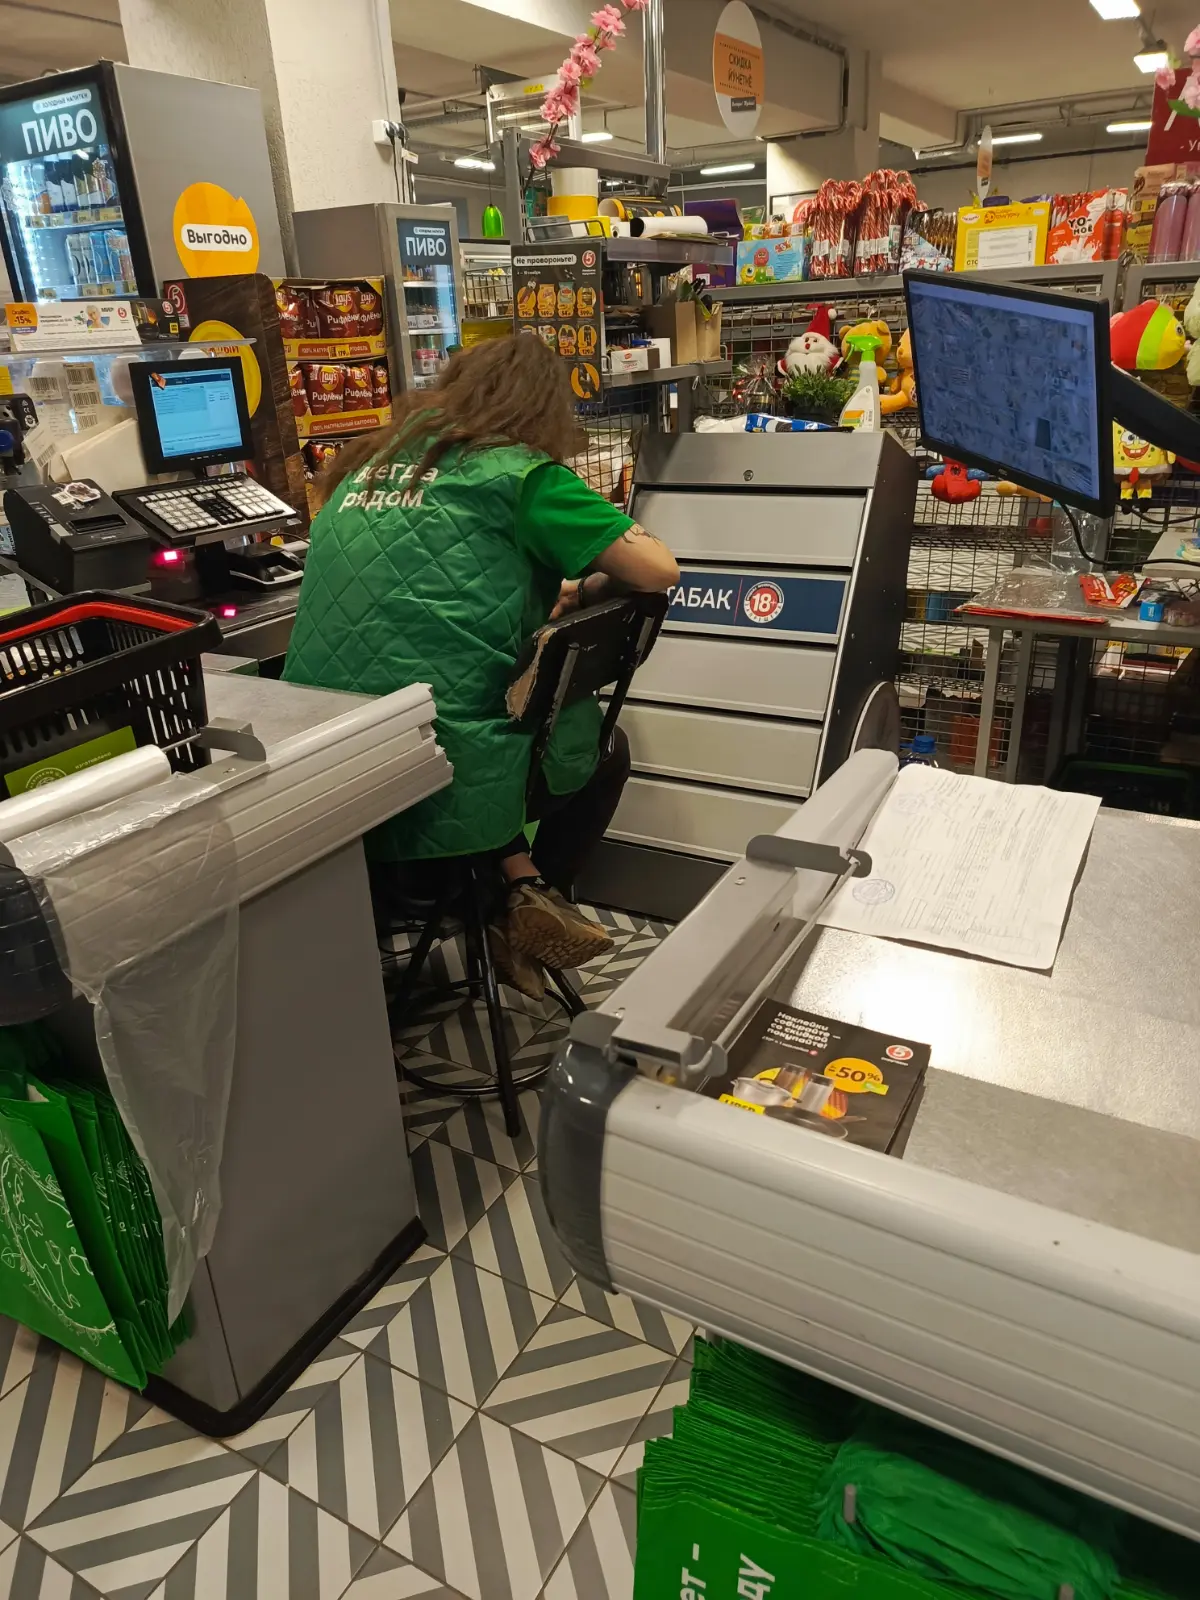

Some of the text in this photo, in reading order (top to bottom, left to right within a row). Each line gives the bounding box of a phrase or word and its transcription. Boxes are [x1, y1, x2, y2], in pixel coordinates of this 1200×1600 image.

[21, 108, 98, 155] ПИВО
[186, 228, 248, 246] Выгодно
[405, 236, 447, 257] ПИВО
[516, 256, 574, 265] Не провороньте!
[14, 316, 32, 325] -15%
[337, 489, 424, 513] рядом
[665, 585, 733, 610] ТАБАК
[752, 592, 777, 613] 18+
[774, 1017, 831, 1038] собирайте
[777, 1011, 829, 1031] Наклейки
[766, 1027, 828, 1049] покупайте!
[770, 1022, 829, 1043] со скидкой
